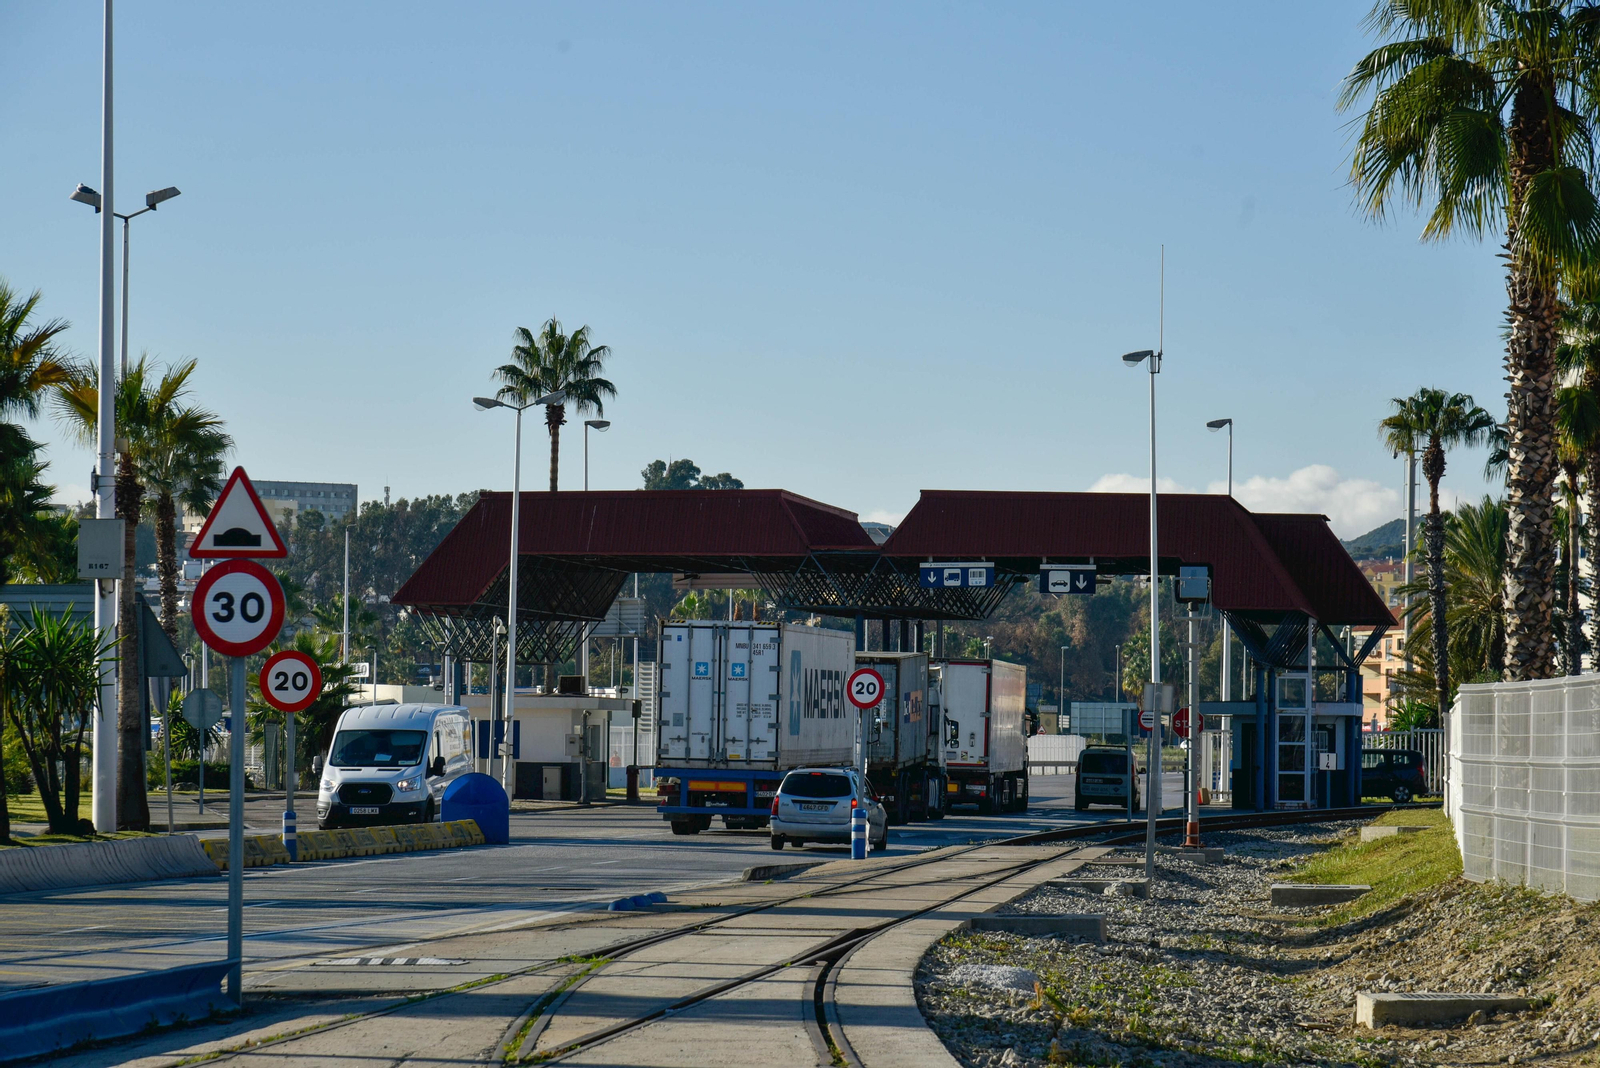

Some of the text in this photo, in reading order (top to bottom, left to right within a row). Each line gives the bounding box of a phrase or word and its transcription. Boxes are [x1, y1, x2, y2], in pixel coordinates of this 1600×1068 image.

[212, 591, 265, 624] 30
[274, 671, 308, 691] 20
[855, 681, 877, 695] 20
[803, 668, 847, 719] MAERSK
[1174, 719, 1202, 728] STP
[1326, 753, 1330, 761] 1
